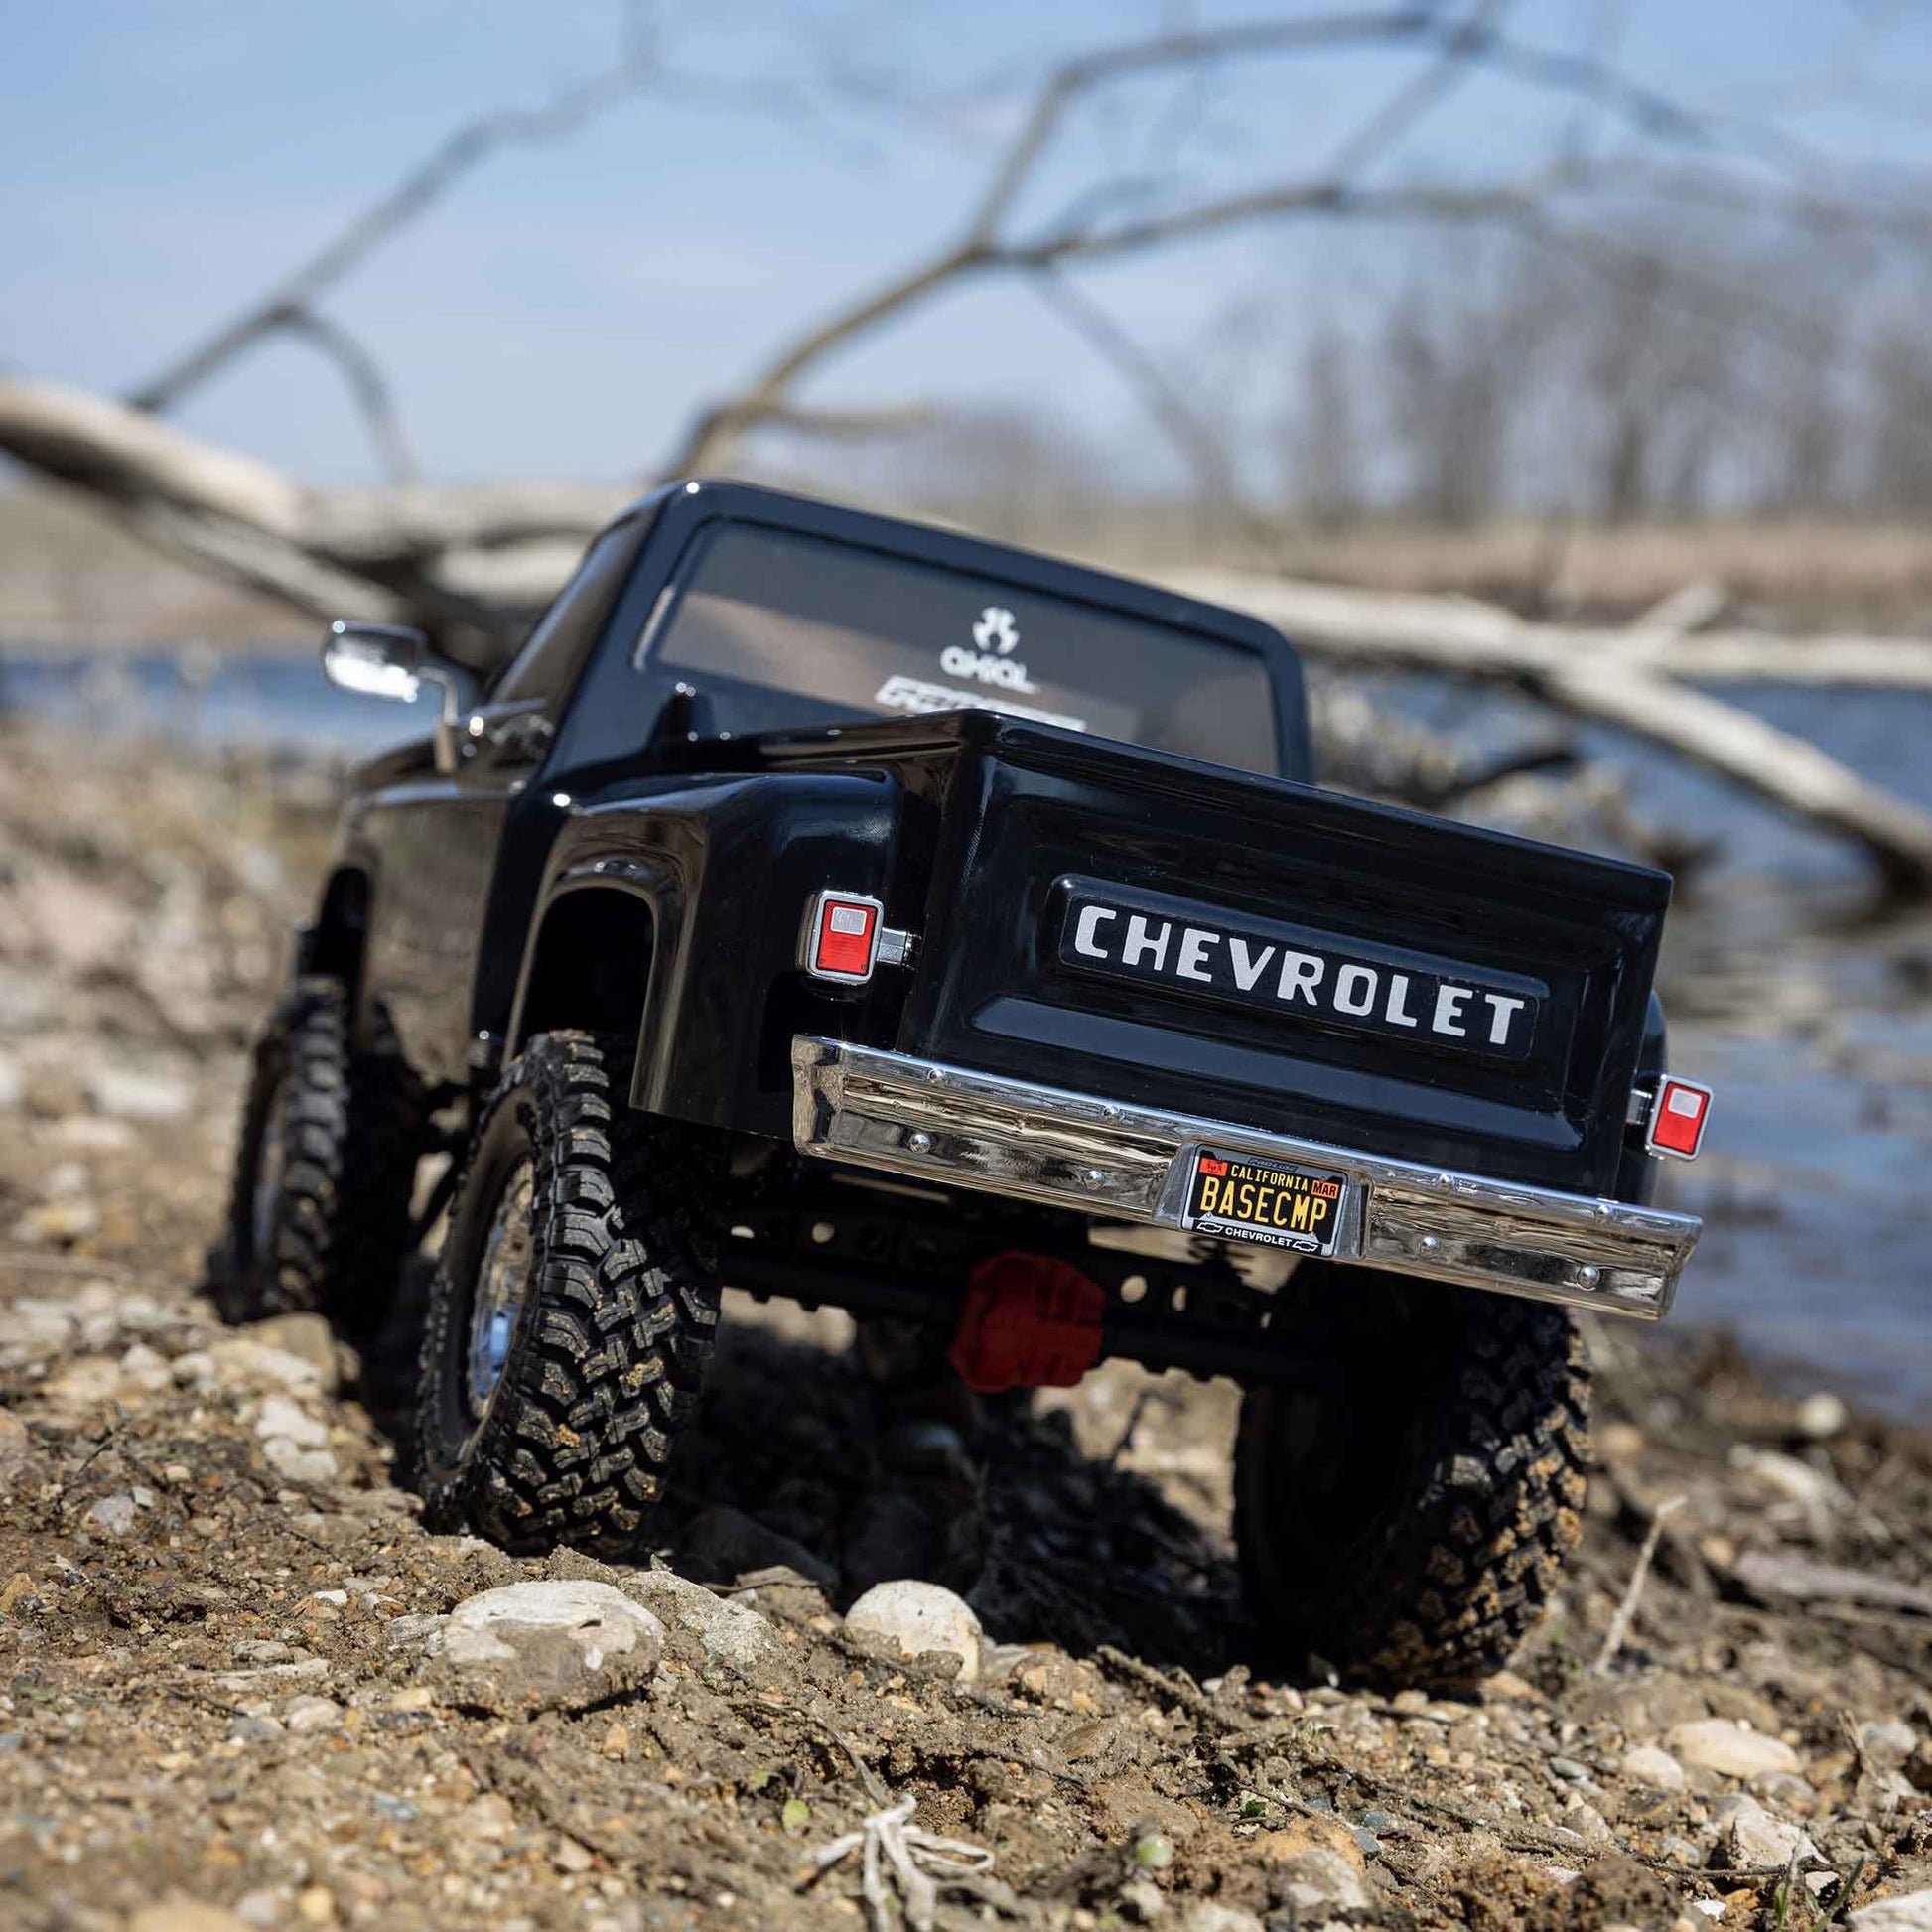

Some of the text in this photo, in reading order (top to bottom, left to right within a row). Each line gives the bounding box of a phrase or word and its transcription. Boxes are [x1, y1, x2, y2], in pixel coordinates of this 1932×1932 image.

[1074, 905, 1525, 1046] CHEVROLET
[1230, 1164, 1308, 1191] CALIFORNIA
[1313, 1181, 1337, 1197] MAR
[1200, 1175, 1327, 1232] BASECMP
[1225, 1226, 1292, 1247] CHEVROLET
